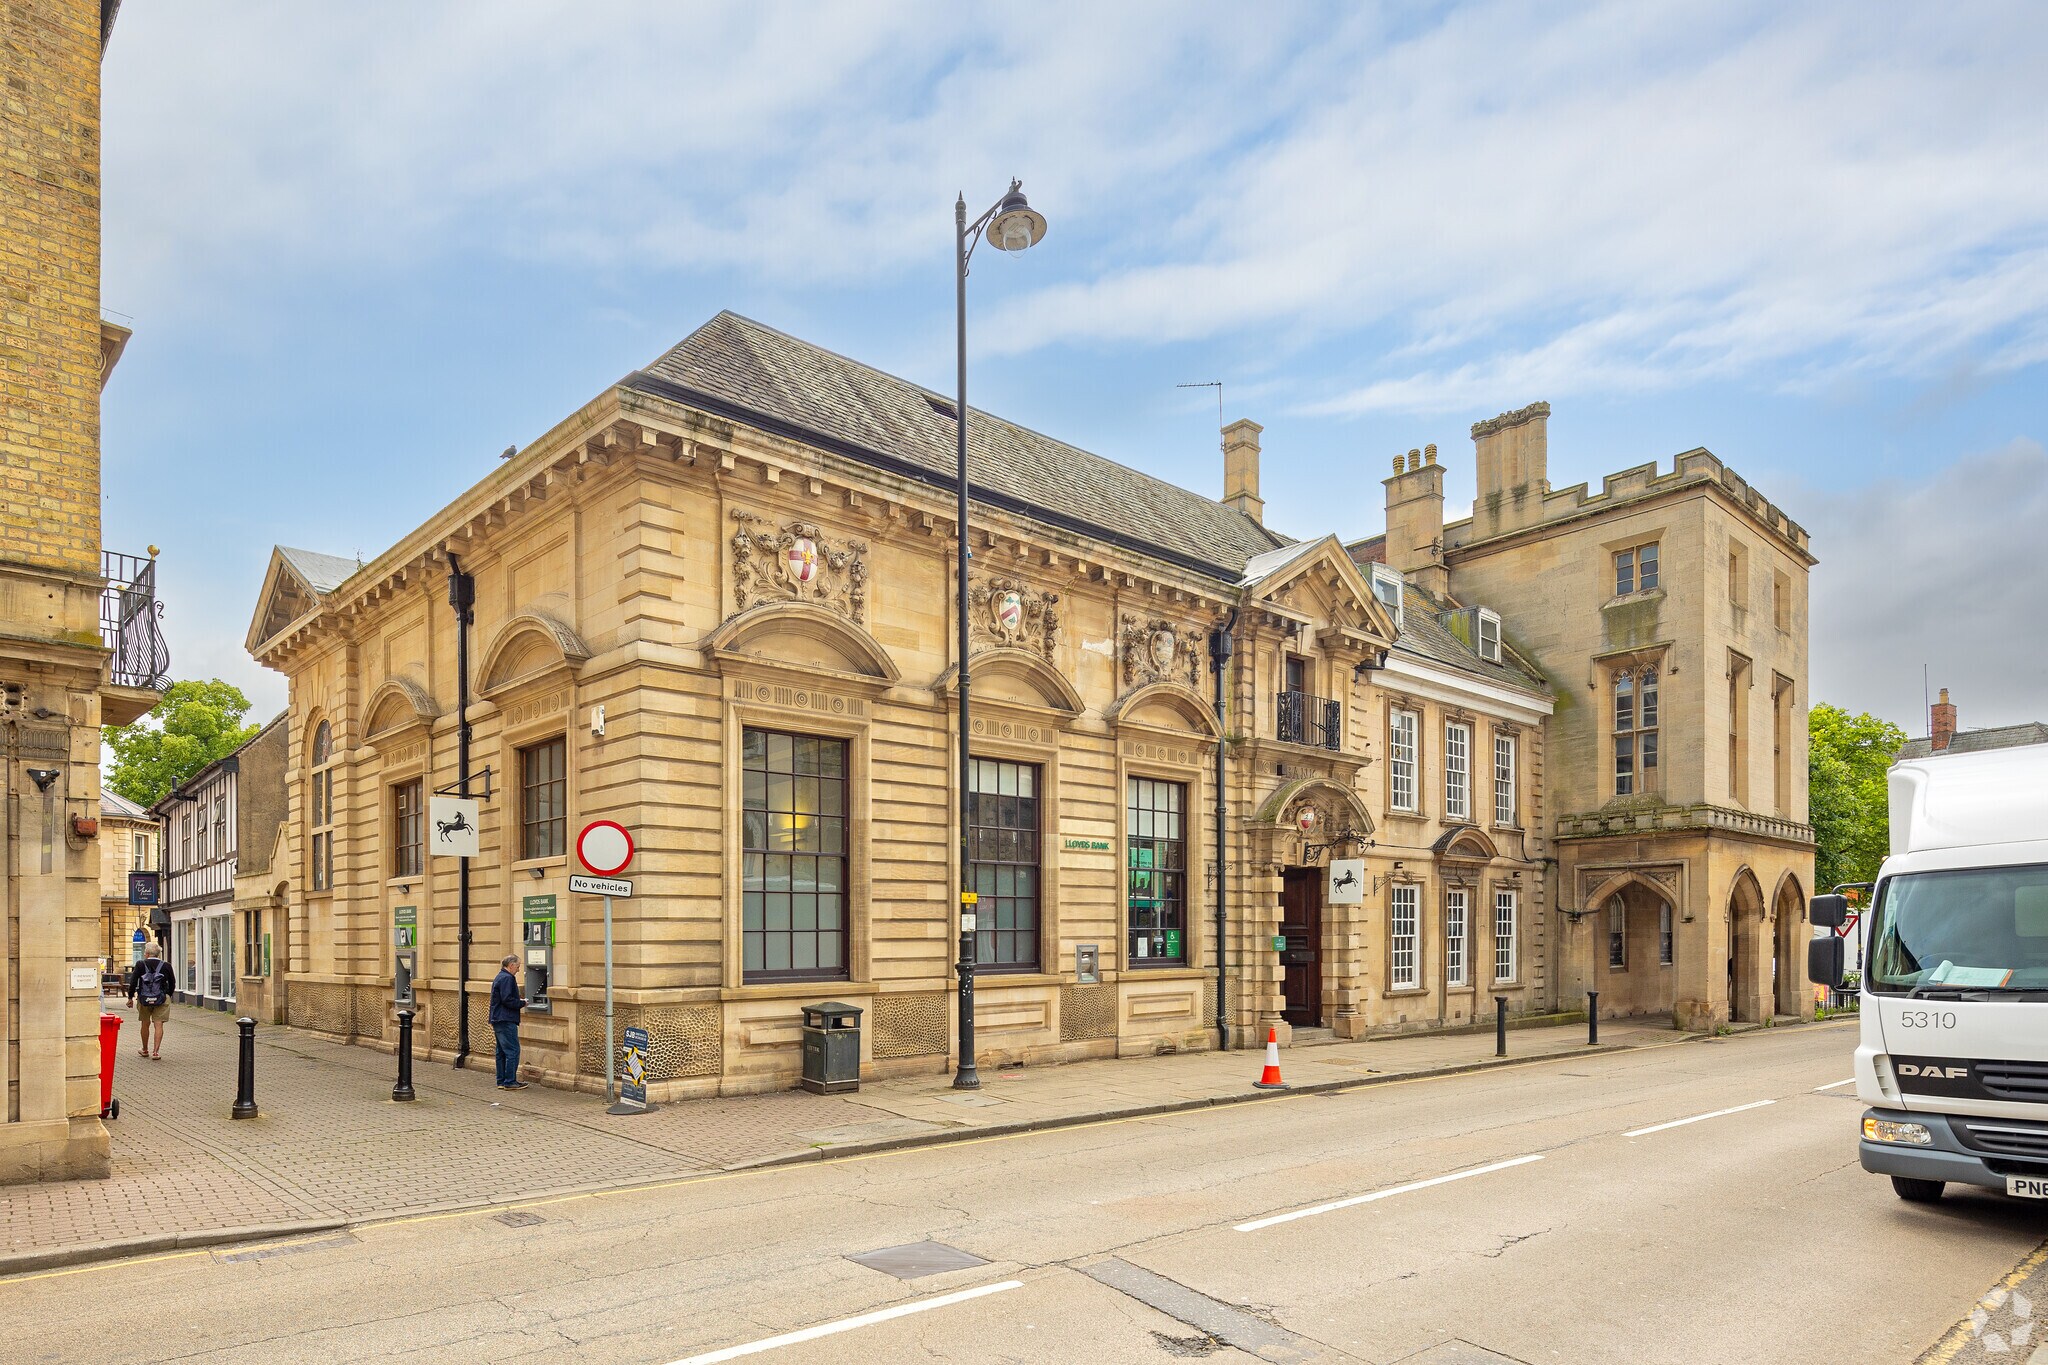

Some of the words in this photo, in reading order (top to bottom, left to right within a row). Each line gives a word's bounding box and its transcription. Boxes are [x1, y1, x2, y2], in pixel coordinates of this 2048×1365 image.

[1287, 766, 1316, 780] BANK
[1065, 840, 1090, 849] LLOYDS
[1091, 842, 1109, 850] BANK
[574, 880, 588, 888] No
[591, 883, 628, 892] vehicles
[1901, 1011, 1957, 1029] 5310
[1898, 1063, 1968, 1079] DAF
